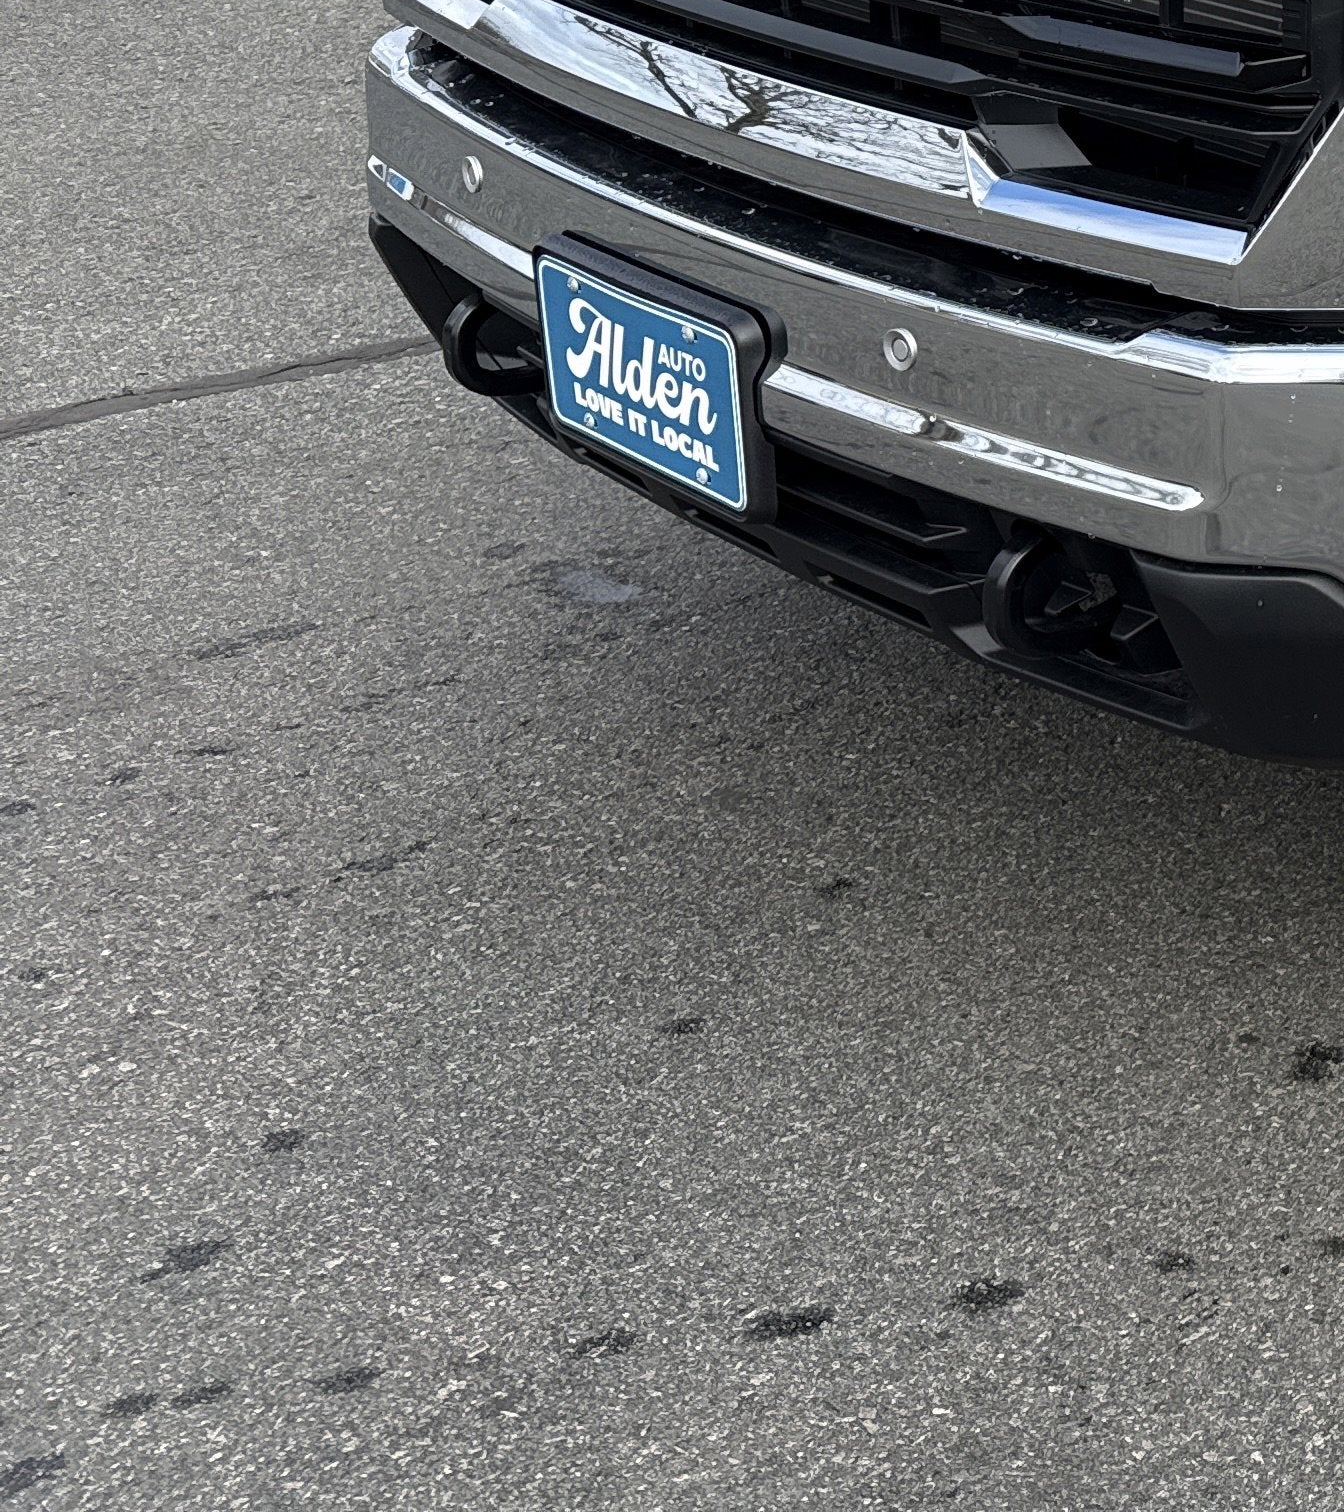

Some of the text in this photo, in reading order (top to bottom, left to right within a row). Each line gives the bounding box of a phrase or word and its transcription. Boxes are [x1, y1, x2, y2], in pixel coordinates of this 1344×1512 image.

[566, 298, 717, 435] Alden
[657, 344, 706, 381] AUTO
[574, 382, 719, 472] LOVE IT LOCAL
